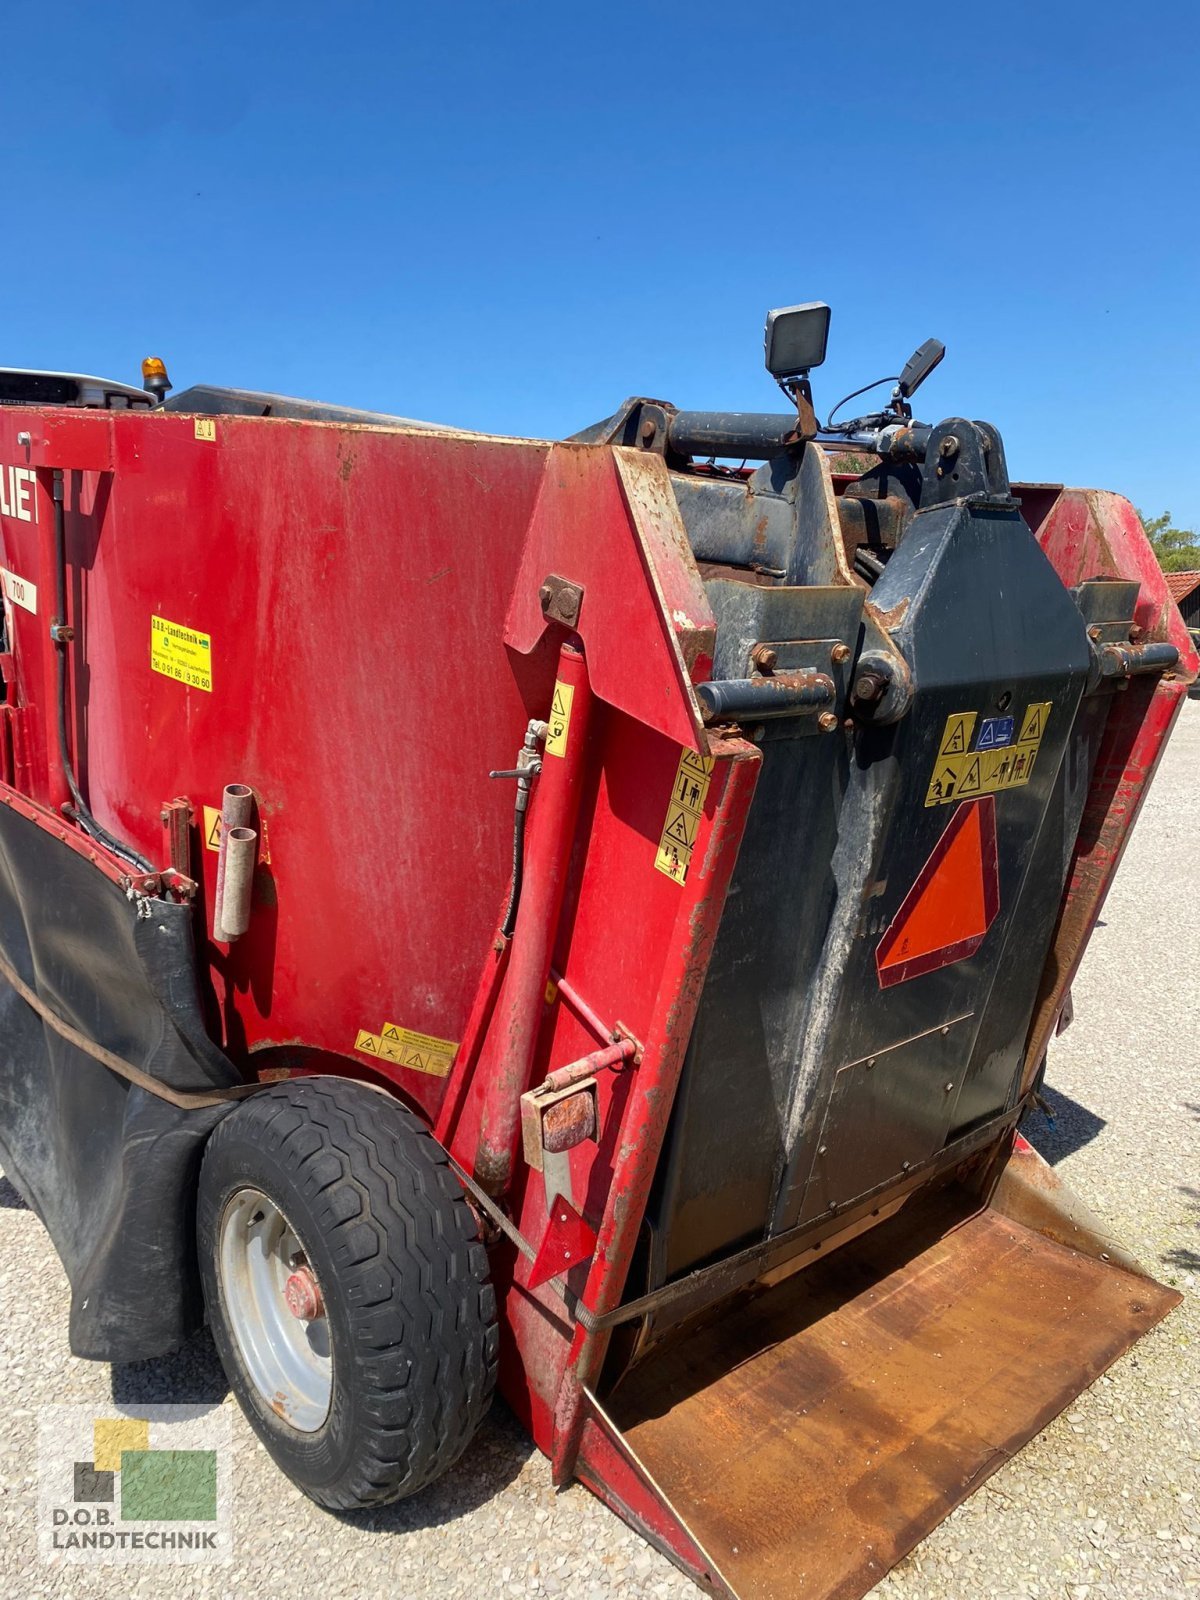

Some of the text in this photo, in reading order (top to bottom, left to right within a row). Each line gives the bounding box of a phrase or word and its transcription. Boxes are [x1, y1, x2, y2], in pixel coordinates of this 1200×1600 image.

[12, 580, 25, 601] 700
[191, 674, 200, 685] 30
[201, 678, 210, 689] 60
